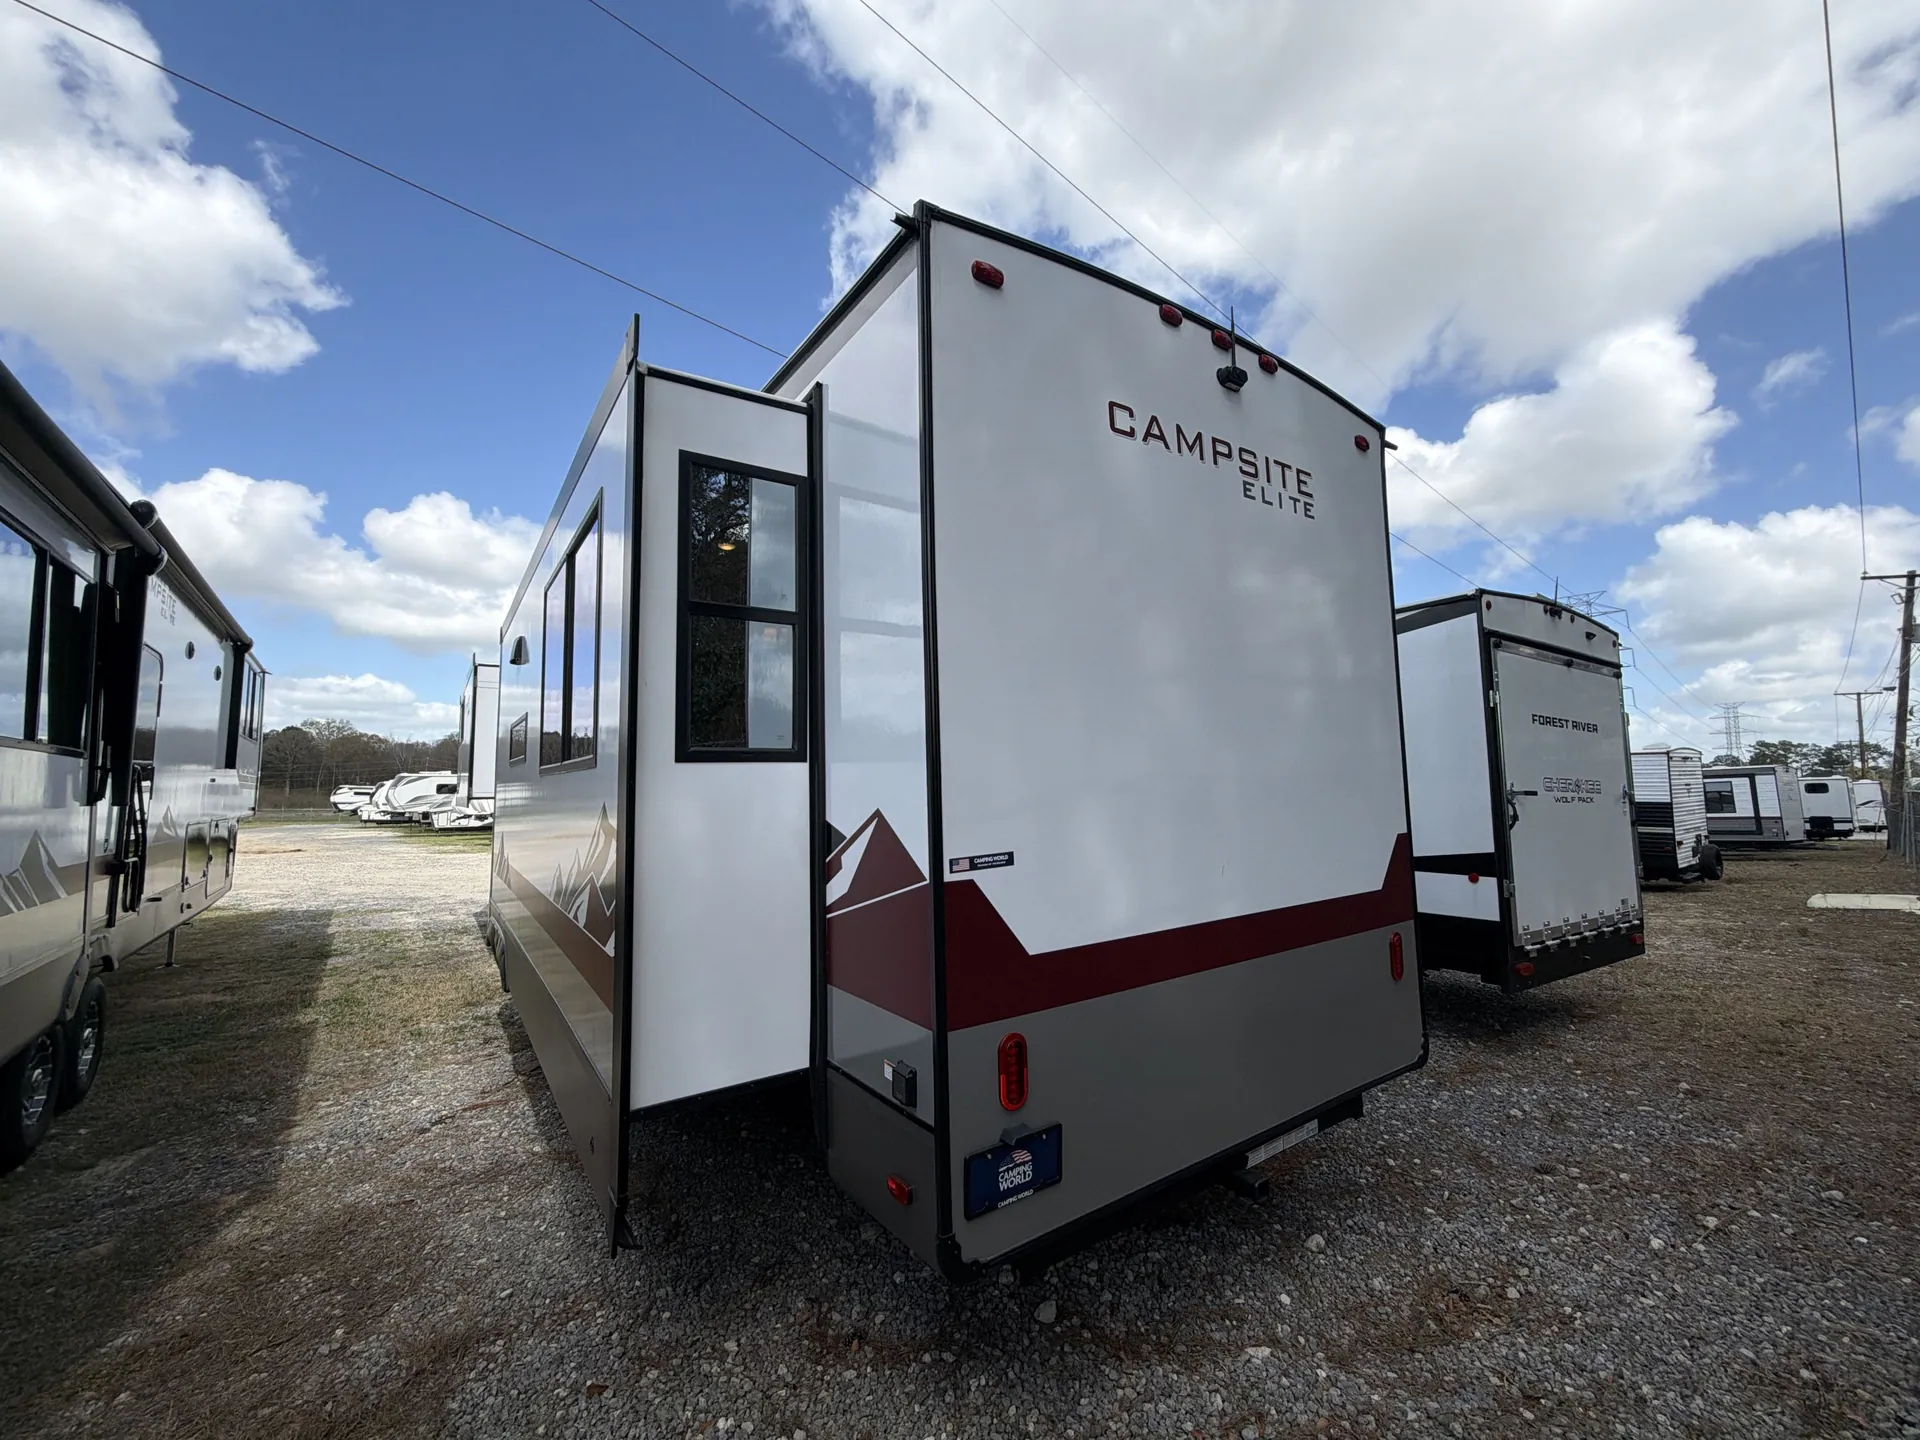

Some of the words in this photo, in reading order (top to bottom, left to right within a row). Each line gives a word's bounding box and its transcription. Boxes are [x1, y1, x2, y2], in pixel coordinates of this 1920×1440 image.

[1108, 400, 1314, 499] CAMPSITE
[1242, 479, 1316, 520] ELITE
[150, 577, 177, 615] MPSITE
[160, 607, 176, 626] ELTE
[1531, 713, 1570, 730] FOREST
[1571, 720, 1599, 734] RIVER
[1553, 795, 1576, 804] WOLF
[1577, 796, 1595, 804] PACK
[973, 856, 994, 864] CAMPING
[998, 1162, 1033, 1182] CAMPING
[998, 1171, 1033, 1192] WORLD
[997, 1194, 1018, 1208] CAMPING
[1017, 1188, 1034, 1200] WORLD
